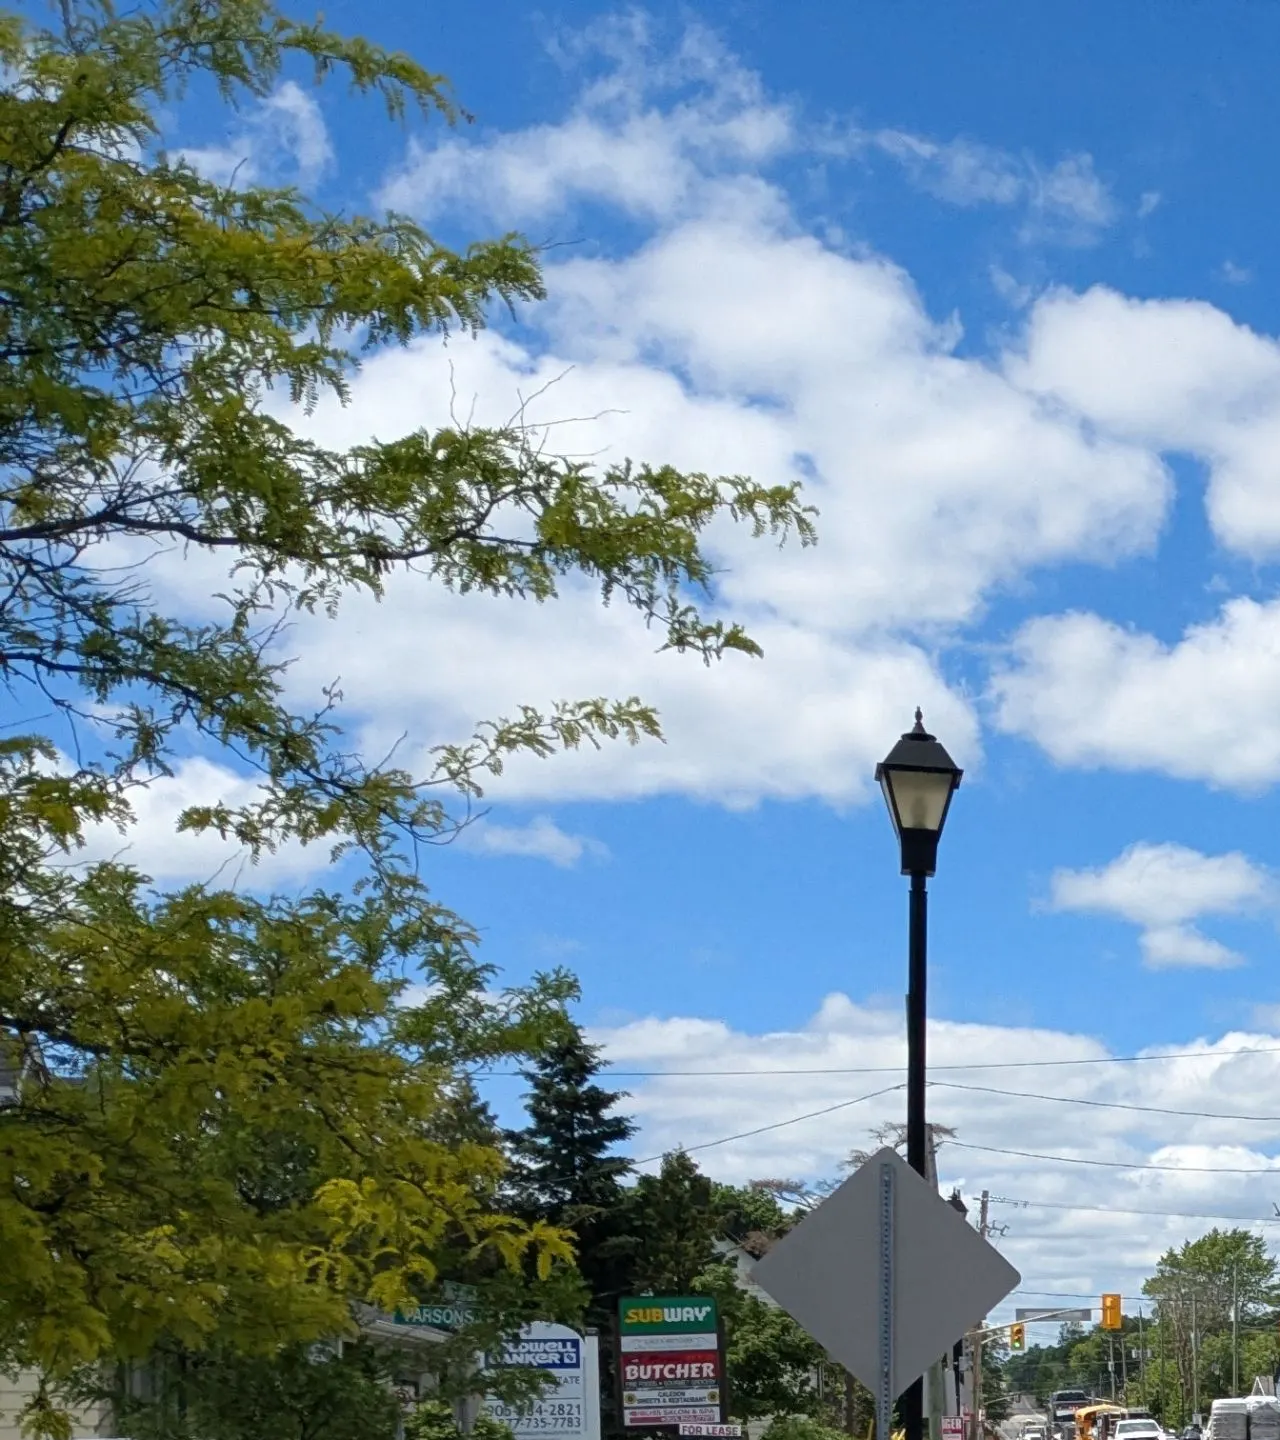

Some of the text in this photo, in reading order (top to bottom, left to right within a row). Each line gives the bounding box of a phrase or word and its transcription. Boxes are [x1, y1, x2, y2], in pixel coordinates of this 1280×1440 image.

[403, 1307, 475, 1325] PARSONS
[624, 1306, 711, 1323] SUBWAY
[625, 1362, 715, 1380] BUTCHER
[682, 1425, 739, 1436] FOR LEASE
